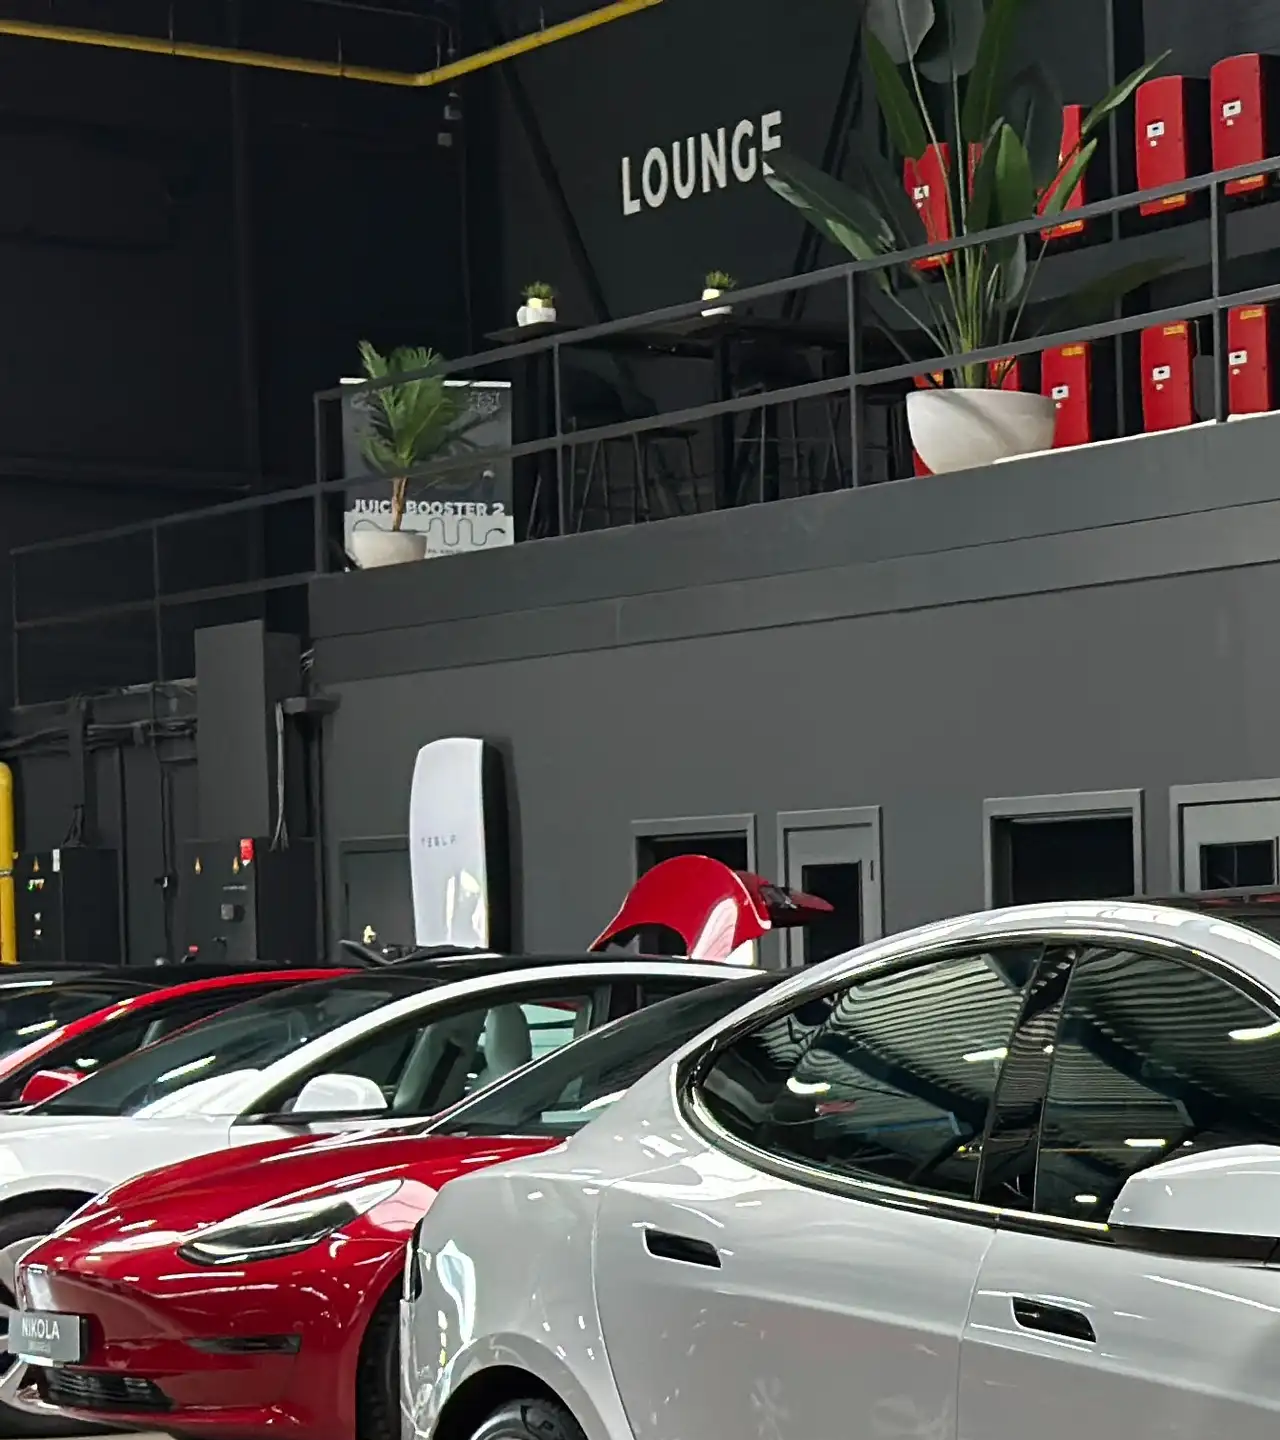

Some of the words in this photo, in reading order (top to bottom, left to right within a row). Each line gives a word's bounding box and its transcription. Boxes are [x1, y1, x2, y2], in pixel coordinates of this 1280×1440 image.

[621, 109, 782, 216] LOUNGE
[353, 499, 394, 514] JUIC
[406, 500, 489, 517] BOOSTER
[492, 502, 505, 517] 2
[21, 1317, 60, 1340] NIKOLA
